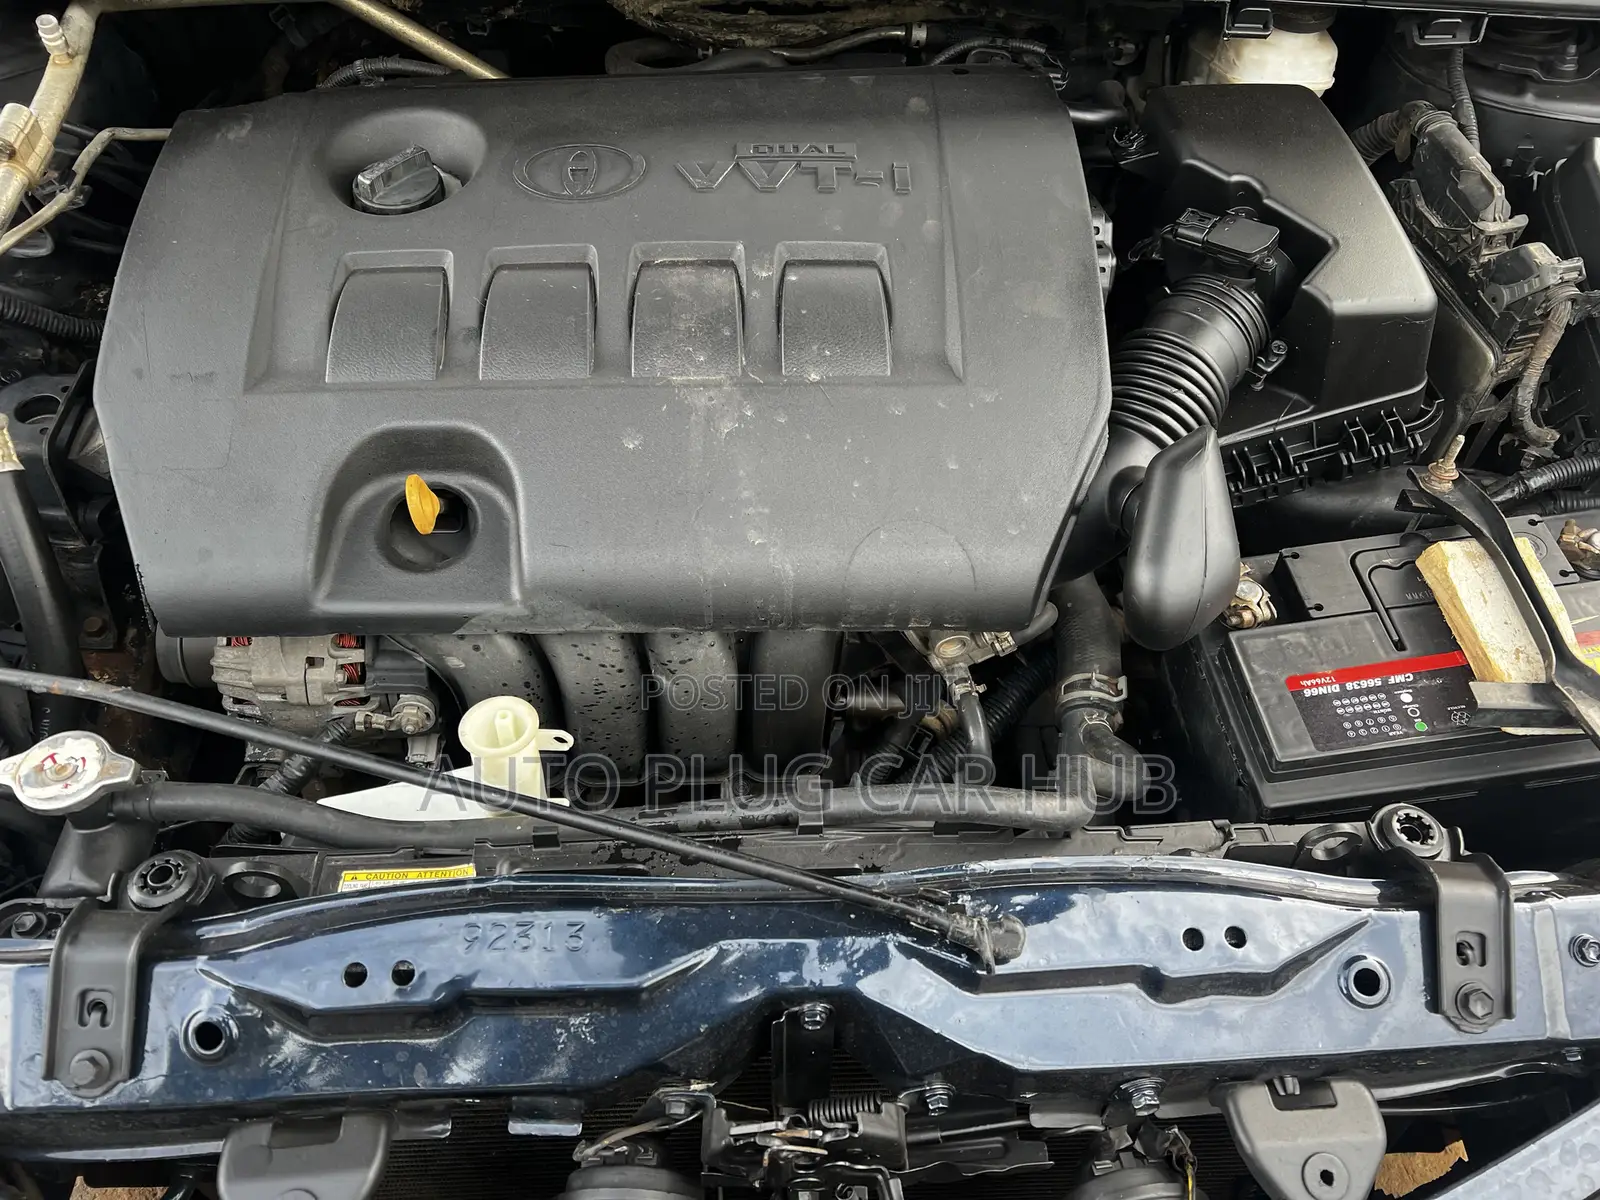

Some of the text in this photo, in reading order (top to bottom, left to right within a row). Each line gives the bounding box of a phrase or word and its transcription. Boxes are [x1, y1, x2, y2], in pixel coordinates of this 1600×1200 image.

[750, 143, 847, 155] DUAL
[1300, 676, 1336, 687] 12V66Ah
[1303, 673, 1414, 697] CMF 56638 DIN66
[366, 868, 469, 880] CAUTION ATTENTION
[462, 920, 586, 955] 92313
